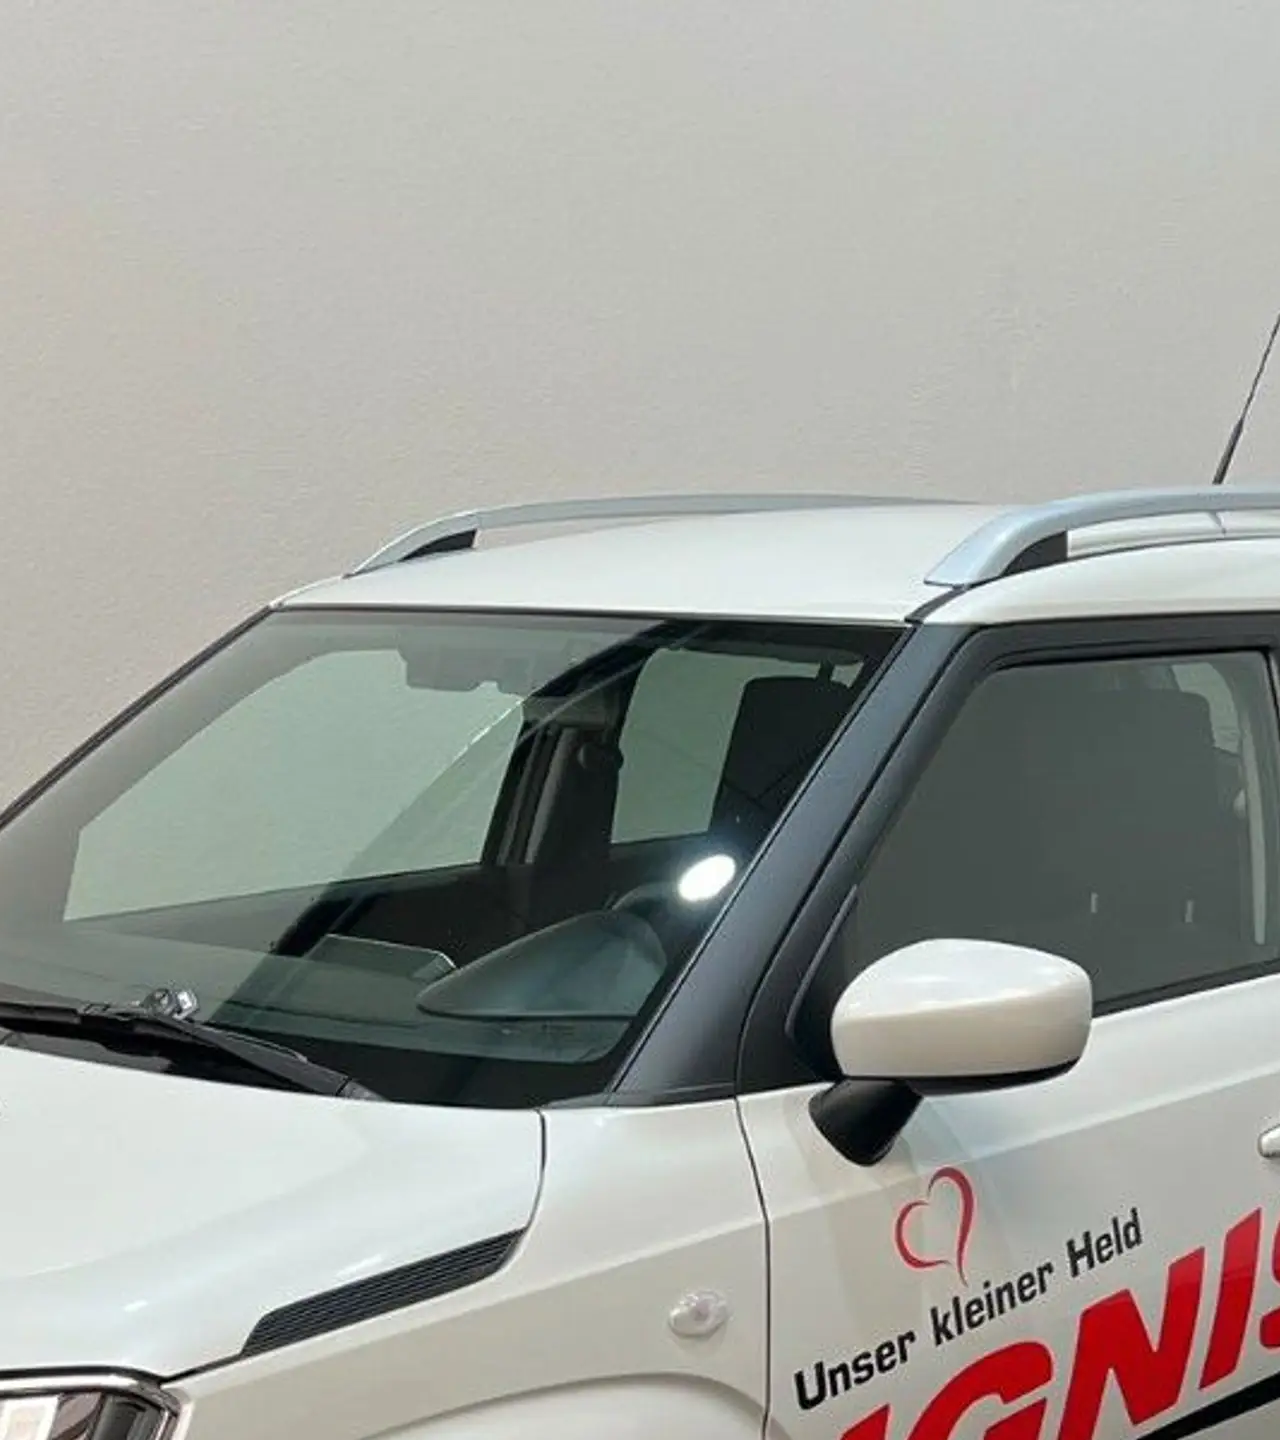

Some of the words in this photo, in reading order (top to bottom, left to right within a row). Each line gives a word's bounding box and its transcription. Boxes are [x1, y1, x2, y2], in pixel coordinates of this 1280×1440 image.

[793, 1329, 917, 1412] Unser
[929, 1260, 1055, 1347] kleiner
[1065, 1206, 1144, 1278] Held
